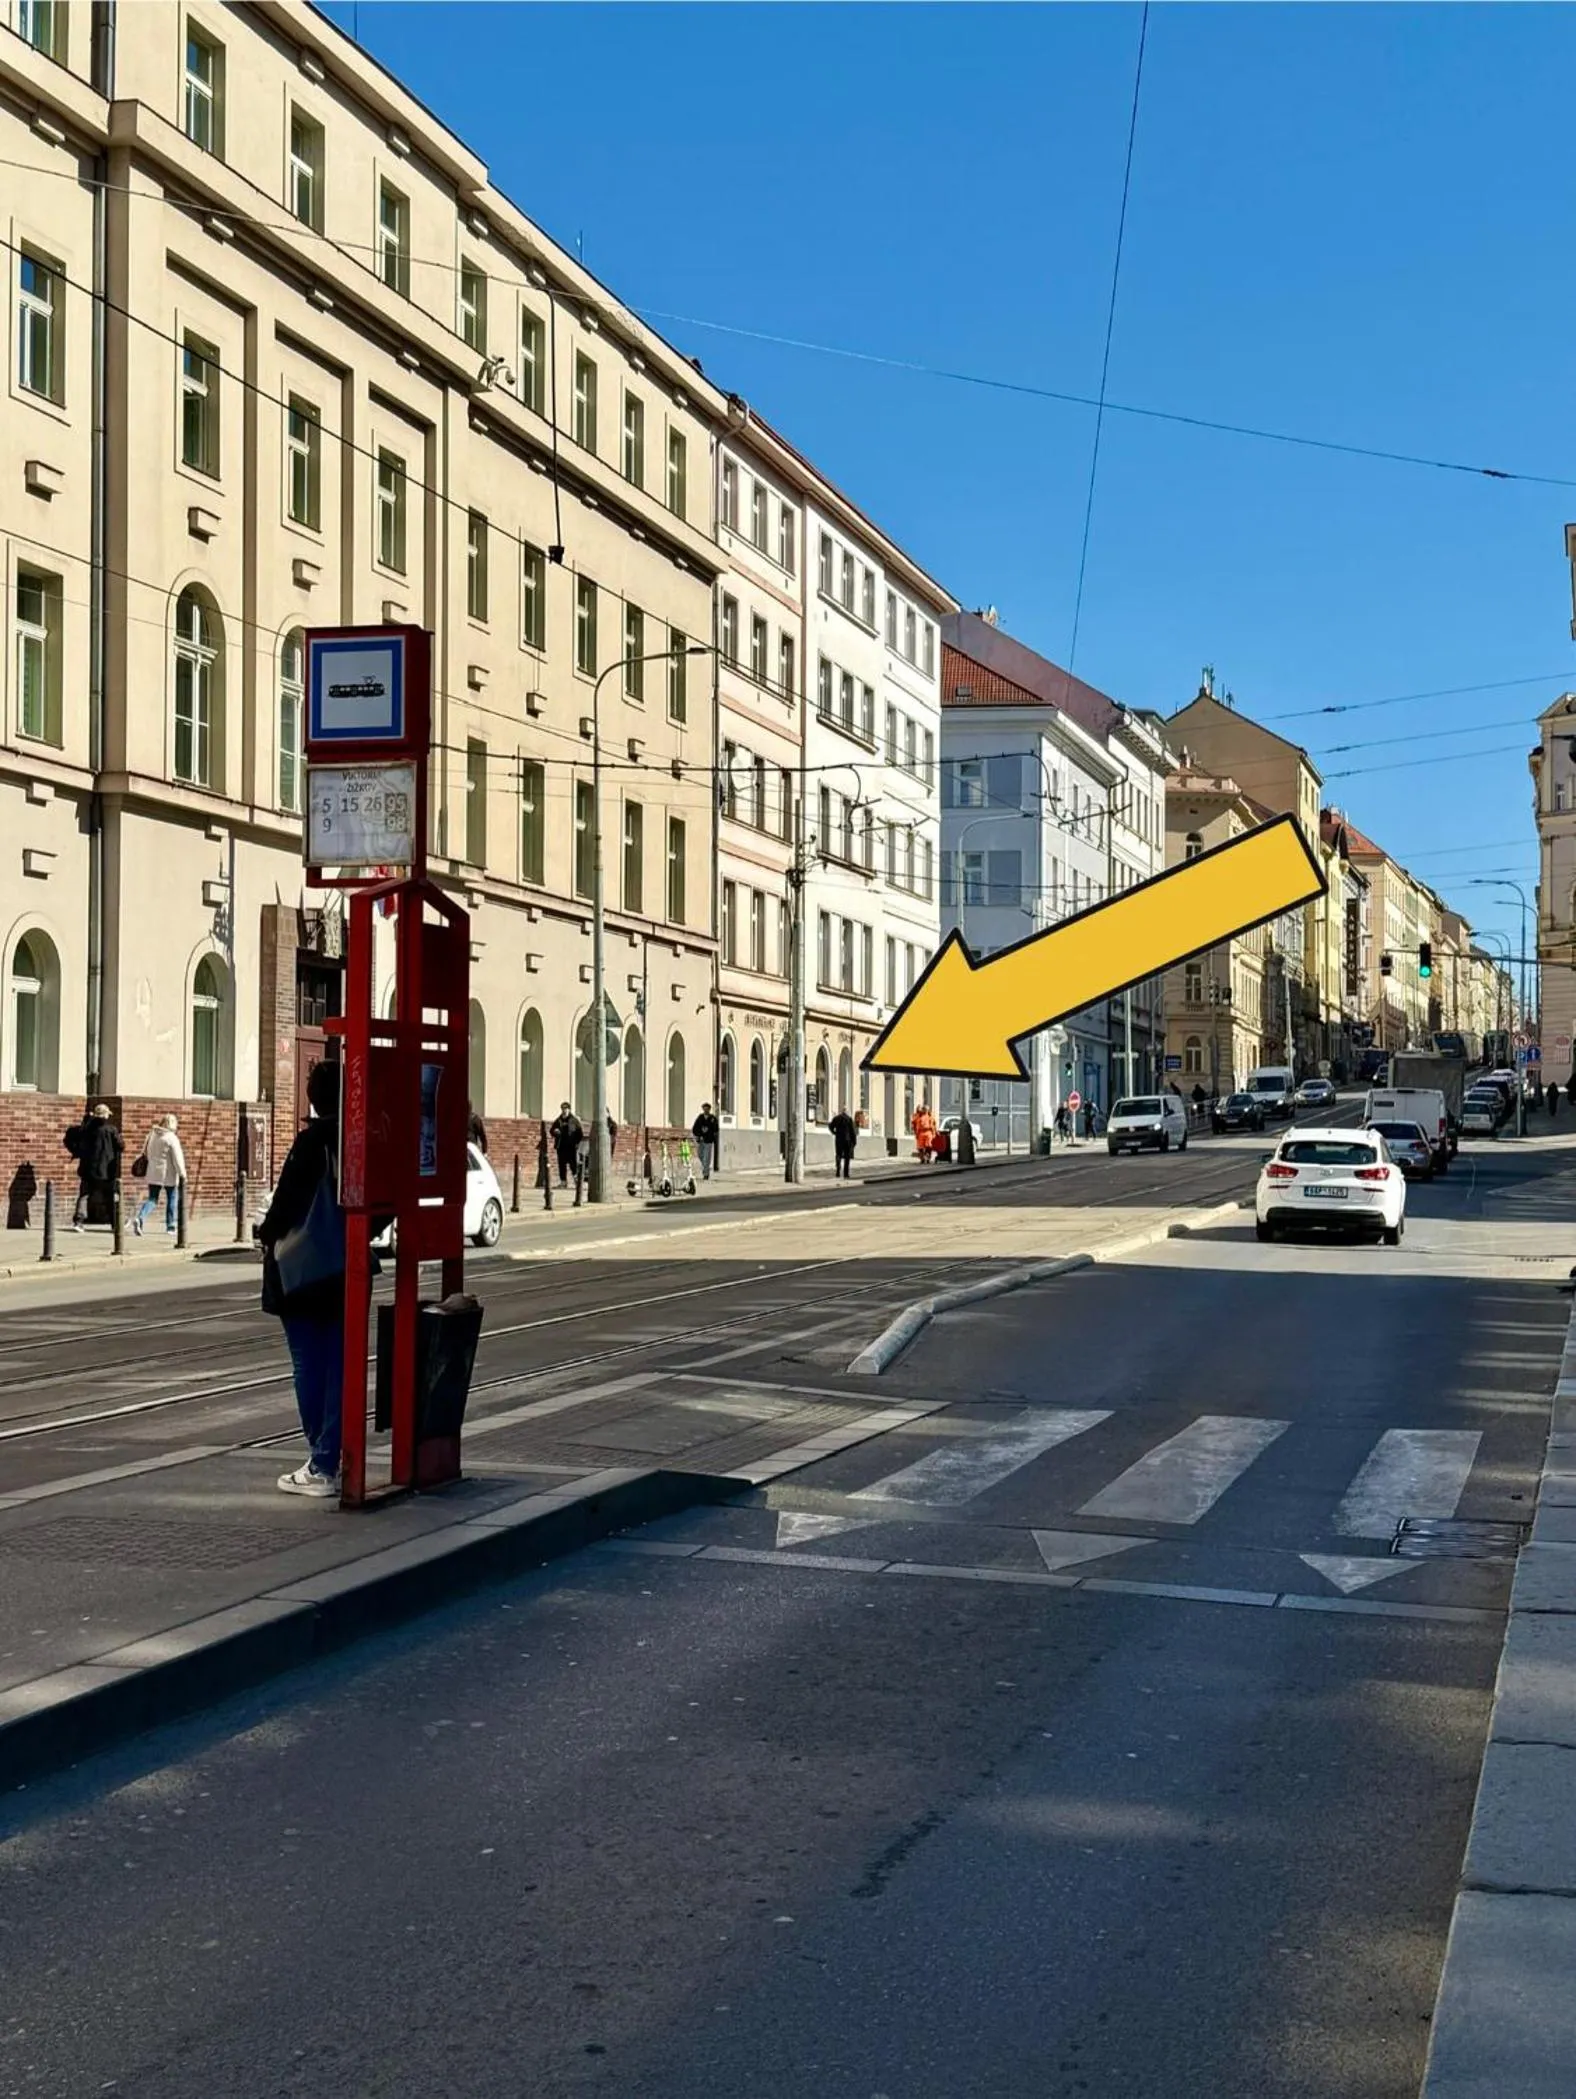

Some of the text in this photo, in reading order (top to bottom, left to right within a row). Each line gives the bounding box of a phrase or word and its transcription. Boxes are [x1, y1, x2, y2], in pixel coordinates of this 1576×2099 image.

[322, 798, 332, 813] 5
[341, 798, 359, 813] 15
[363, 797, 382, 812] 26
[322, 816, 405, 833] 9 98
